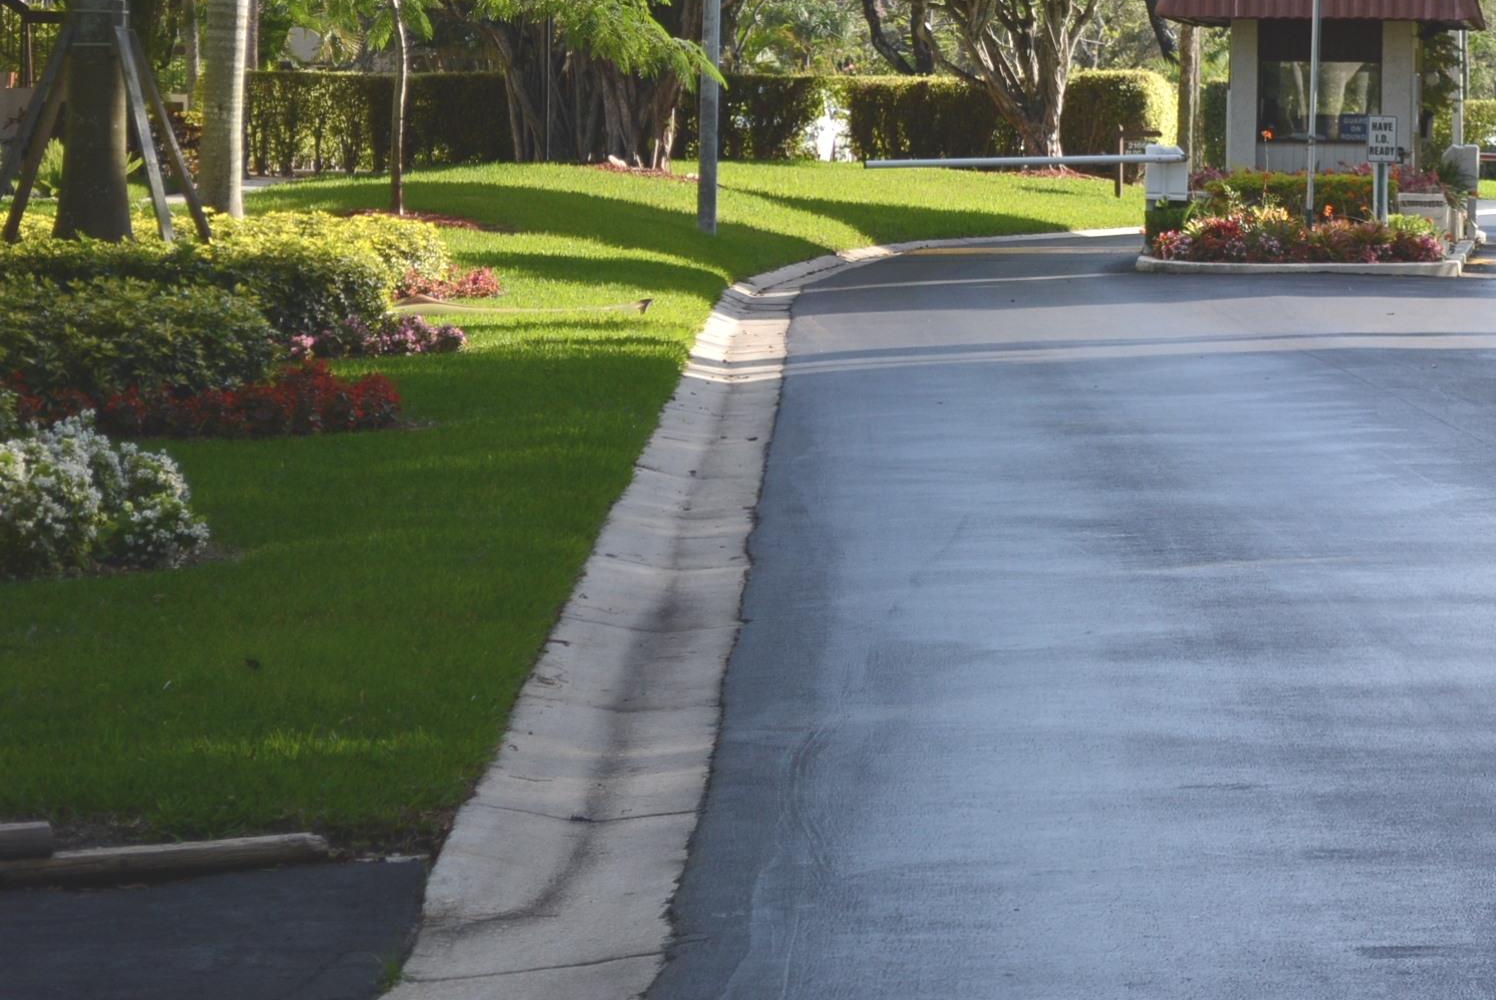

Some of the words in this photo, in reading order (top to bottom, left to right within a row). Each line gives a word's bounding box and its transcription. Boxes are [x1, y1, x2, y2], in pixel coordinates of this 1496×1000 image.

[1371, 122, 1393, 131] HAVE
[1375, 134, 1390, 144] I.D.
[1369, 146, 1395, 156] READY
